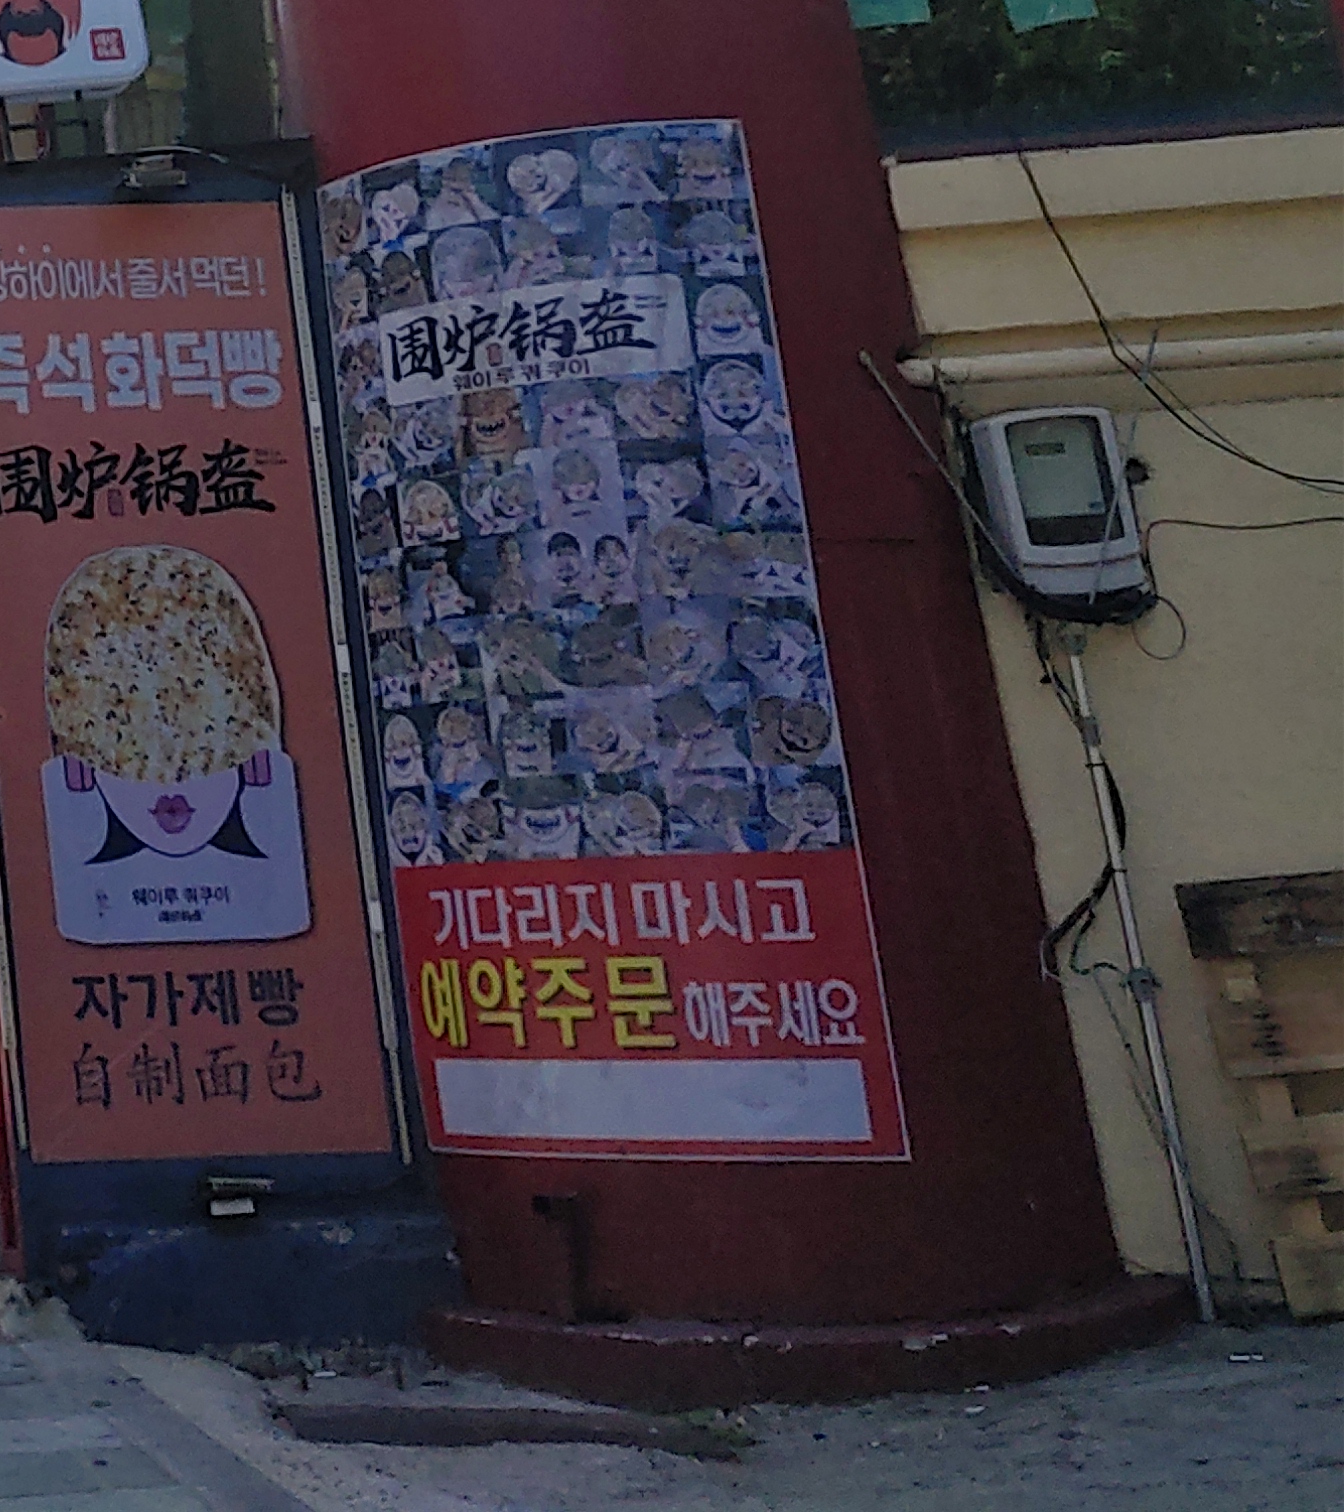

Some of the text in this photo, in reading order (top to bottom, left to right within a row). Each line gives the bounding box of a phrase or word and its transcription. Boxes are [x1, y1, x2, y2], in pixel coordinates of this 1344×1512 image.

[128, 258, 189, 299] 줄서
[428, 878, 816, 949] 기다리지 마시고
[685, 979, 865, 1047] 해주세요
[73, 1039, 323, 1111] 自制面包
